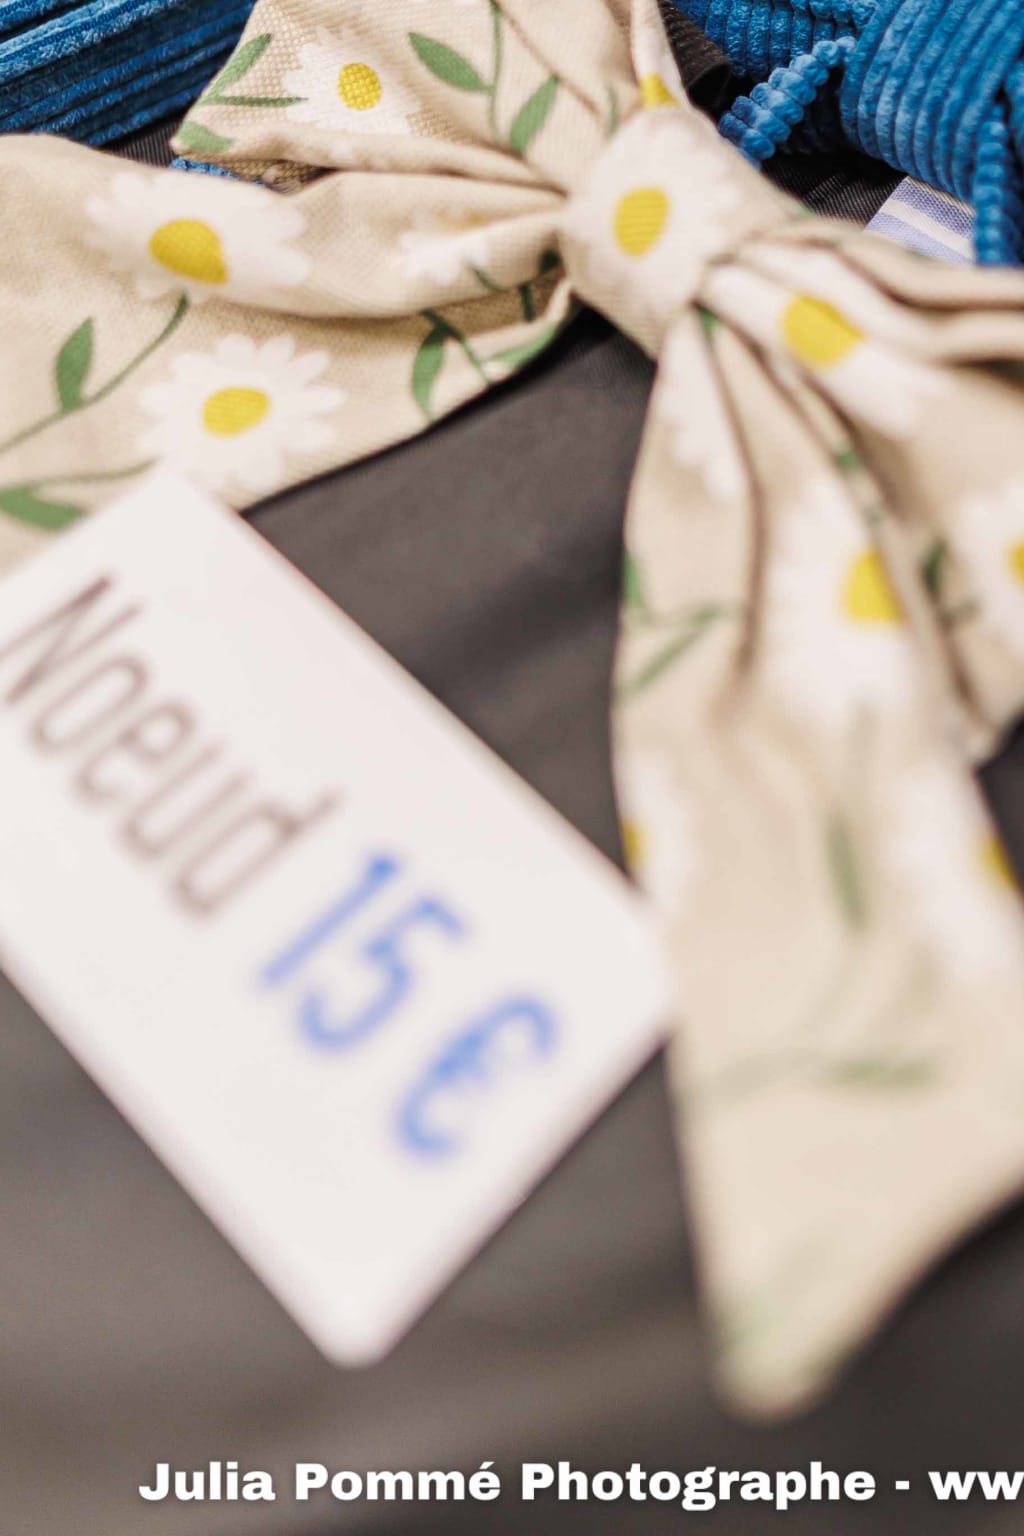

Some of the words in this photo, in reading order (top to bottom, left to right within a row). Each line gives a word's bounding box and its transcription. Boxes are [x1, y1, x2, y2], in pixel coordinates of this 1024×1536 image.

[0, 568, 348, 925] Noeud
[256, 849, 472, 1055] 15
[390, 988, 560, 1160] €
